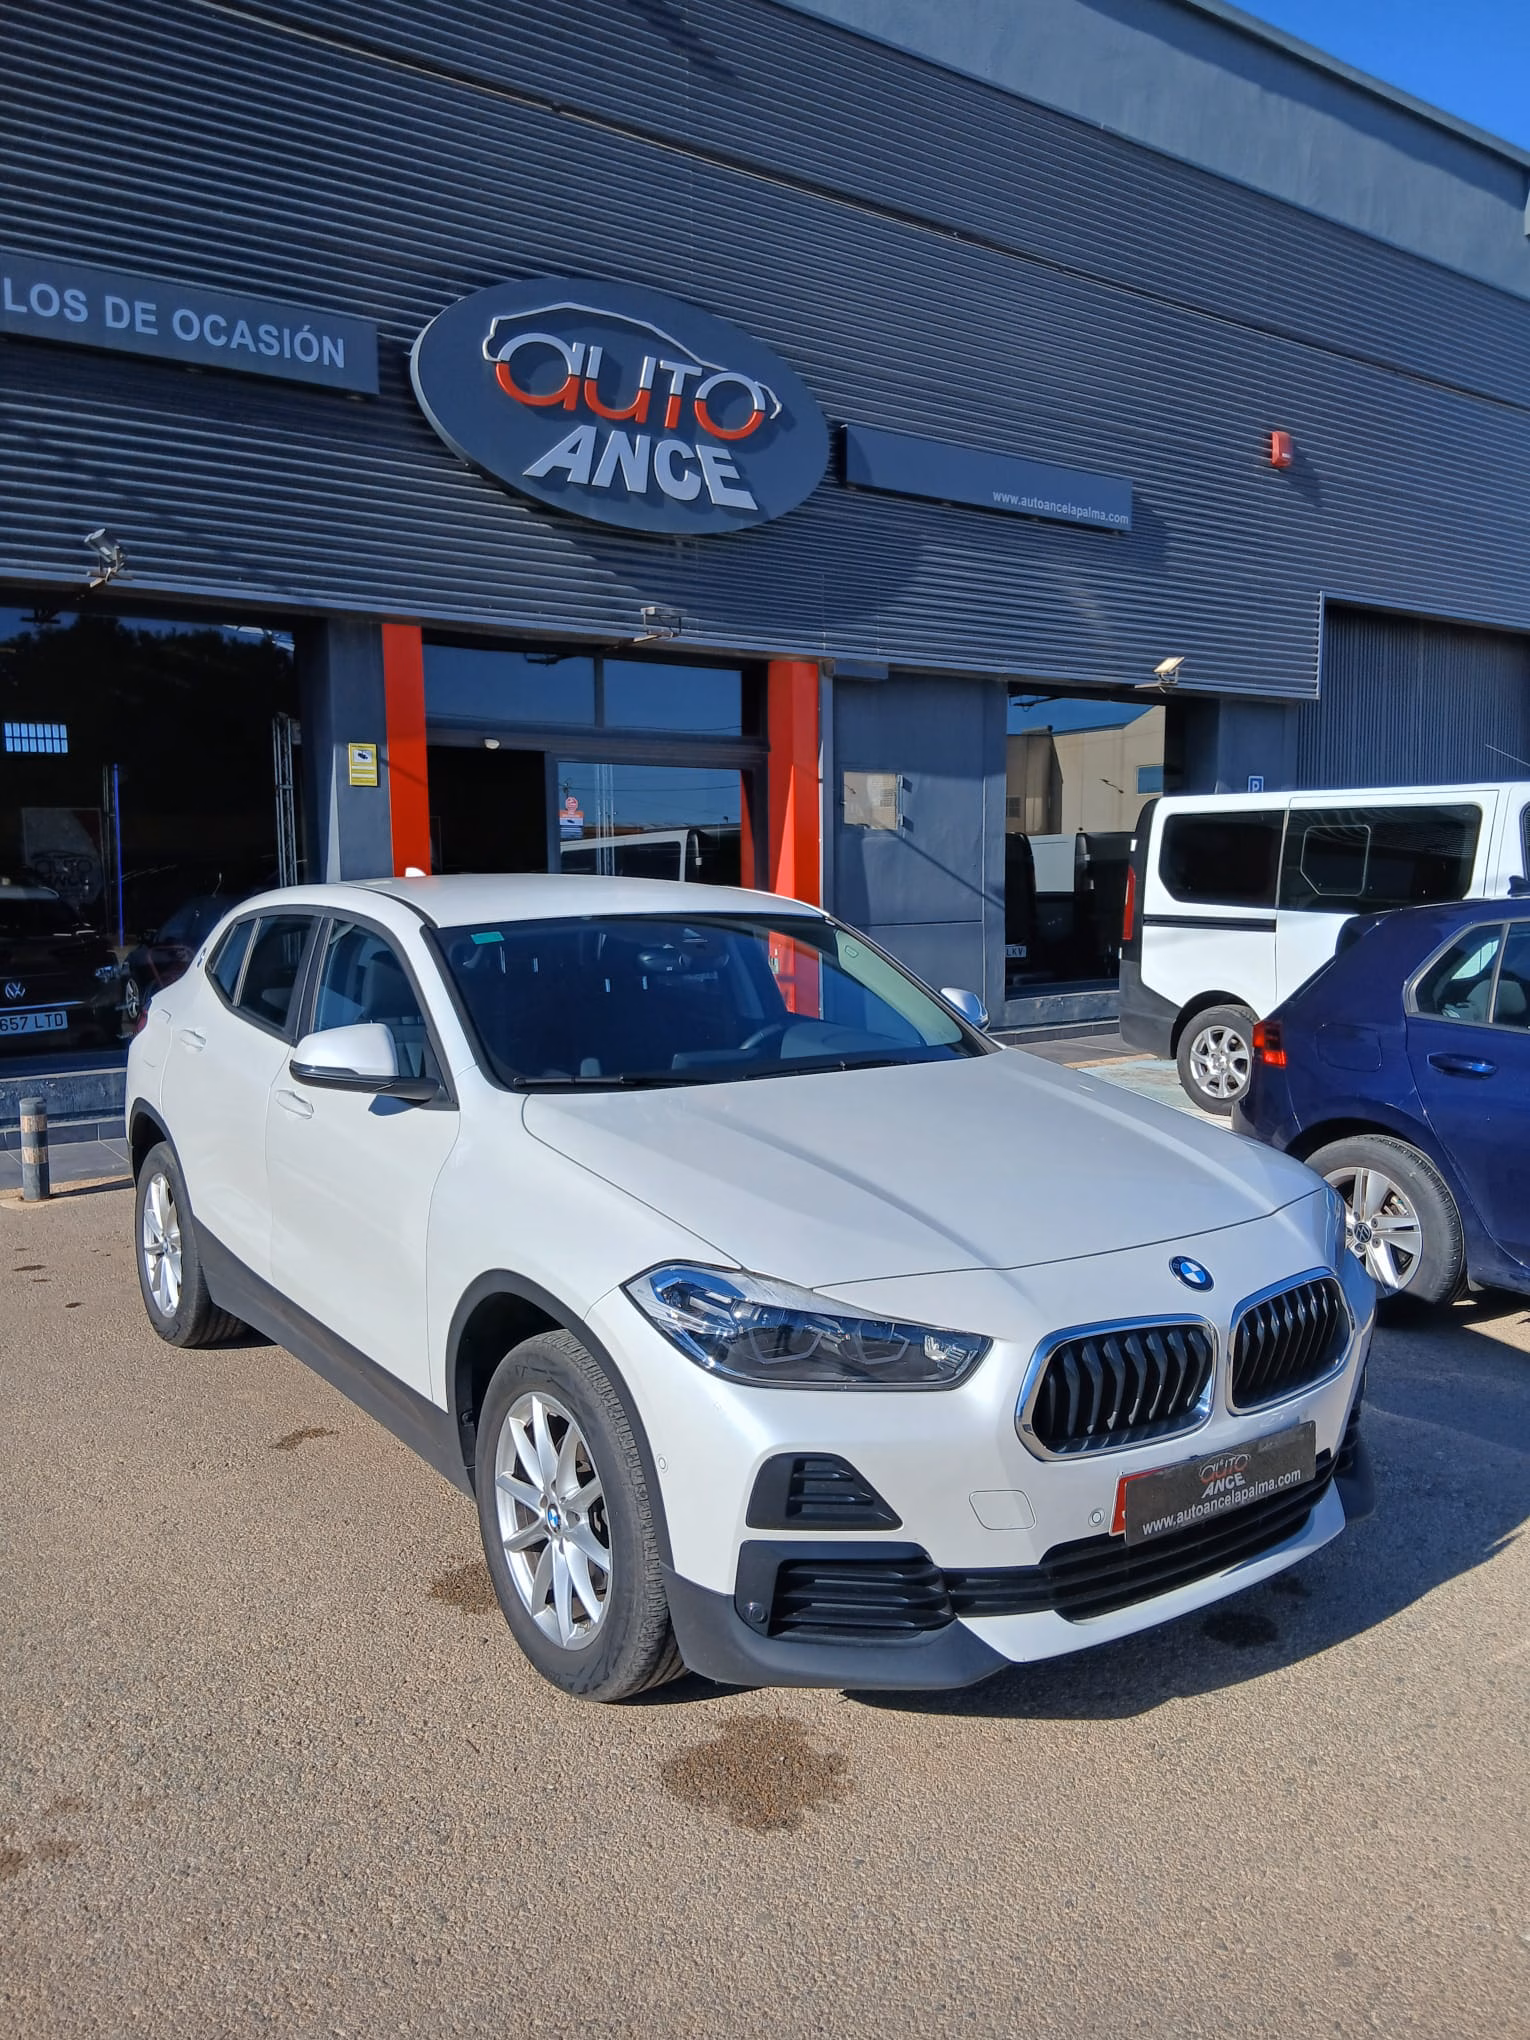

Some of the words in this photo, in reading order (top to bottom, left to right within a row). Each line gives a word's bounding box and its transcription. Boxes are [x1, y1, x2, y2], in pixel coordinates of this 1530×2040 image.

[3, 278, 89, 323] LOS
[104, 295, 159, 335] DE
[172, 309, 345, 369] OCASIÓN
[522, 424, 758, 511] ANCE
[992, 491, 1129, 525] www.autoancelapalma.com
[0, 1016, 28, 1032] 657
[34, 1013, 64, 1029] LTD
[1142, 1469, 1301, 1536] www.autoancelapalma.com
[1201, 1472, 1246, 1499] ANCE
